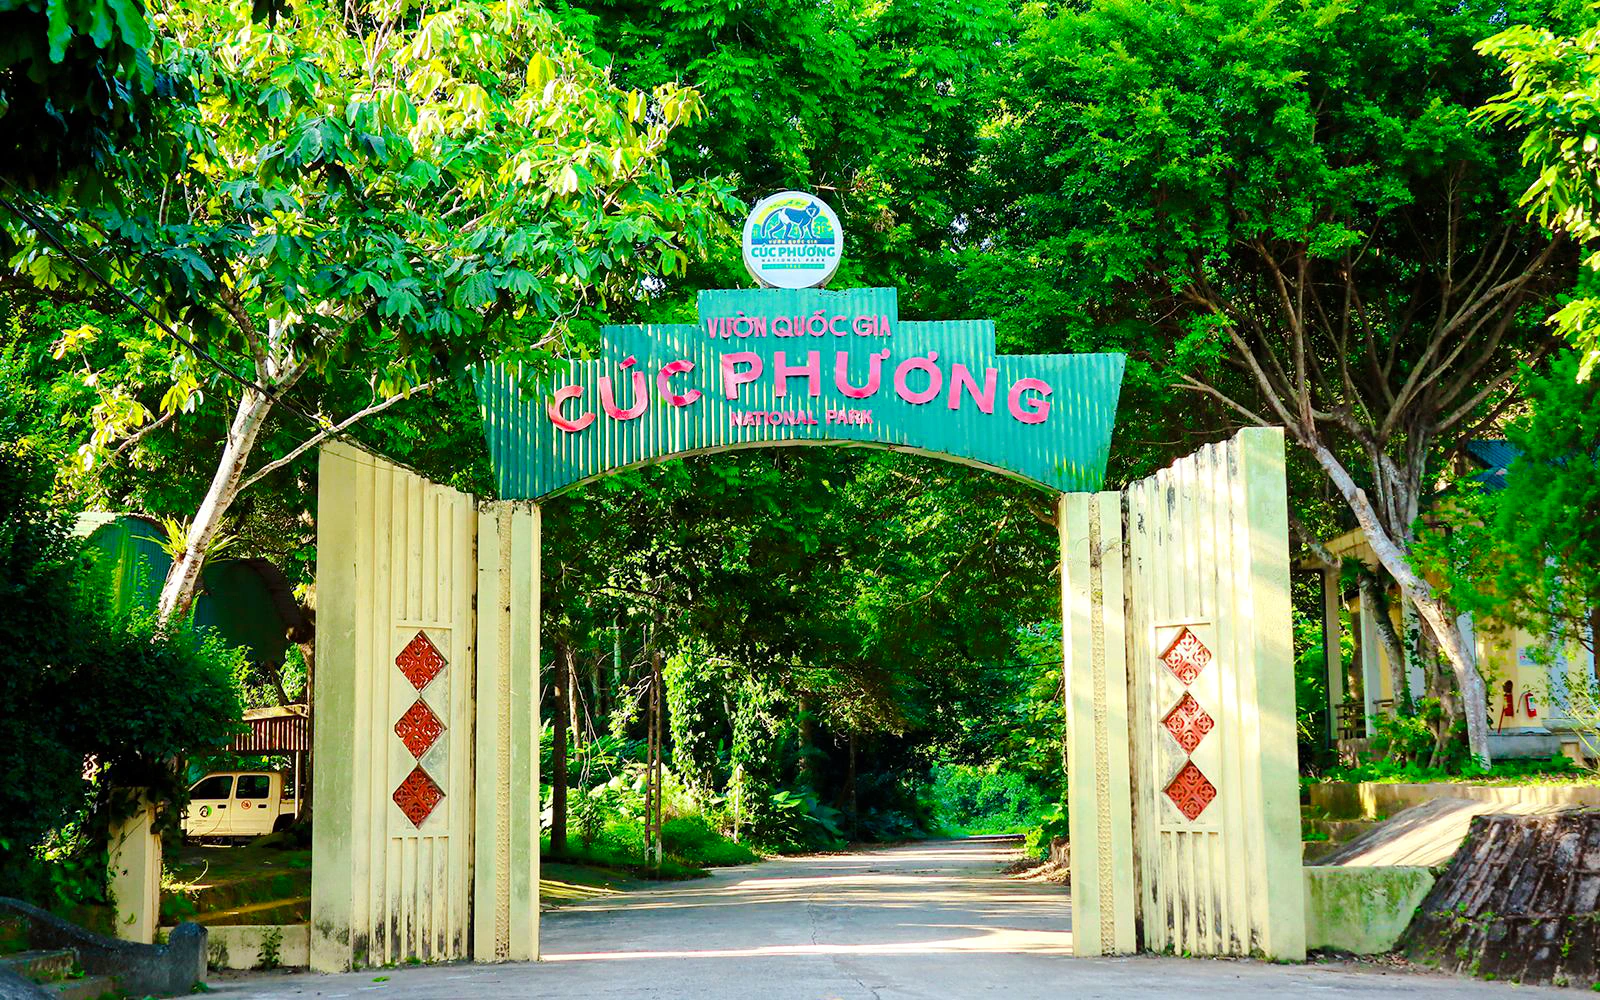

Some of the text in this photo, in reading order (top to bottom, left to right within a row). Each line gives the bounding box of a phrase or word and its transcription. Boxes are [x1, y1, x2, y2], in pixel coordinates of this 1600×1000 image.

[751, 243, 836, 257] CÚC PHƯƠNG
[707, 309, 892, 338] VƯỜN QUỐC GIA
[548, 348, 1054, 433] CÚC PHƯƠNG
[731, 409, 873, 426] NATIONAL PARK
